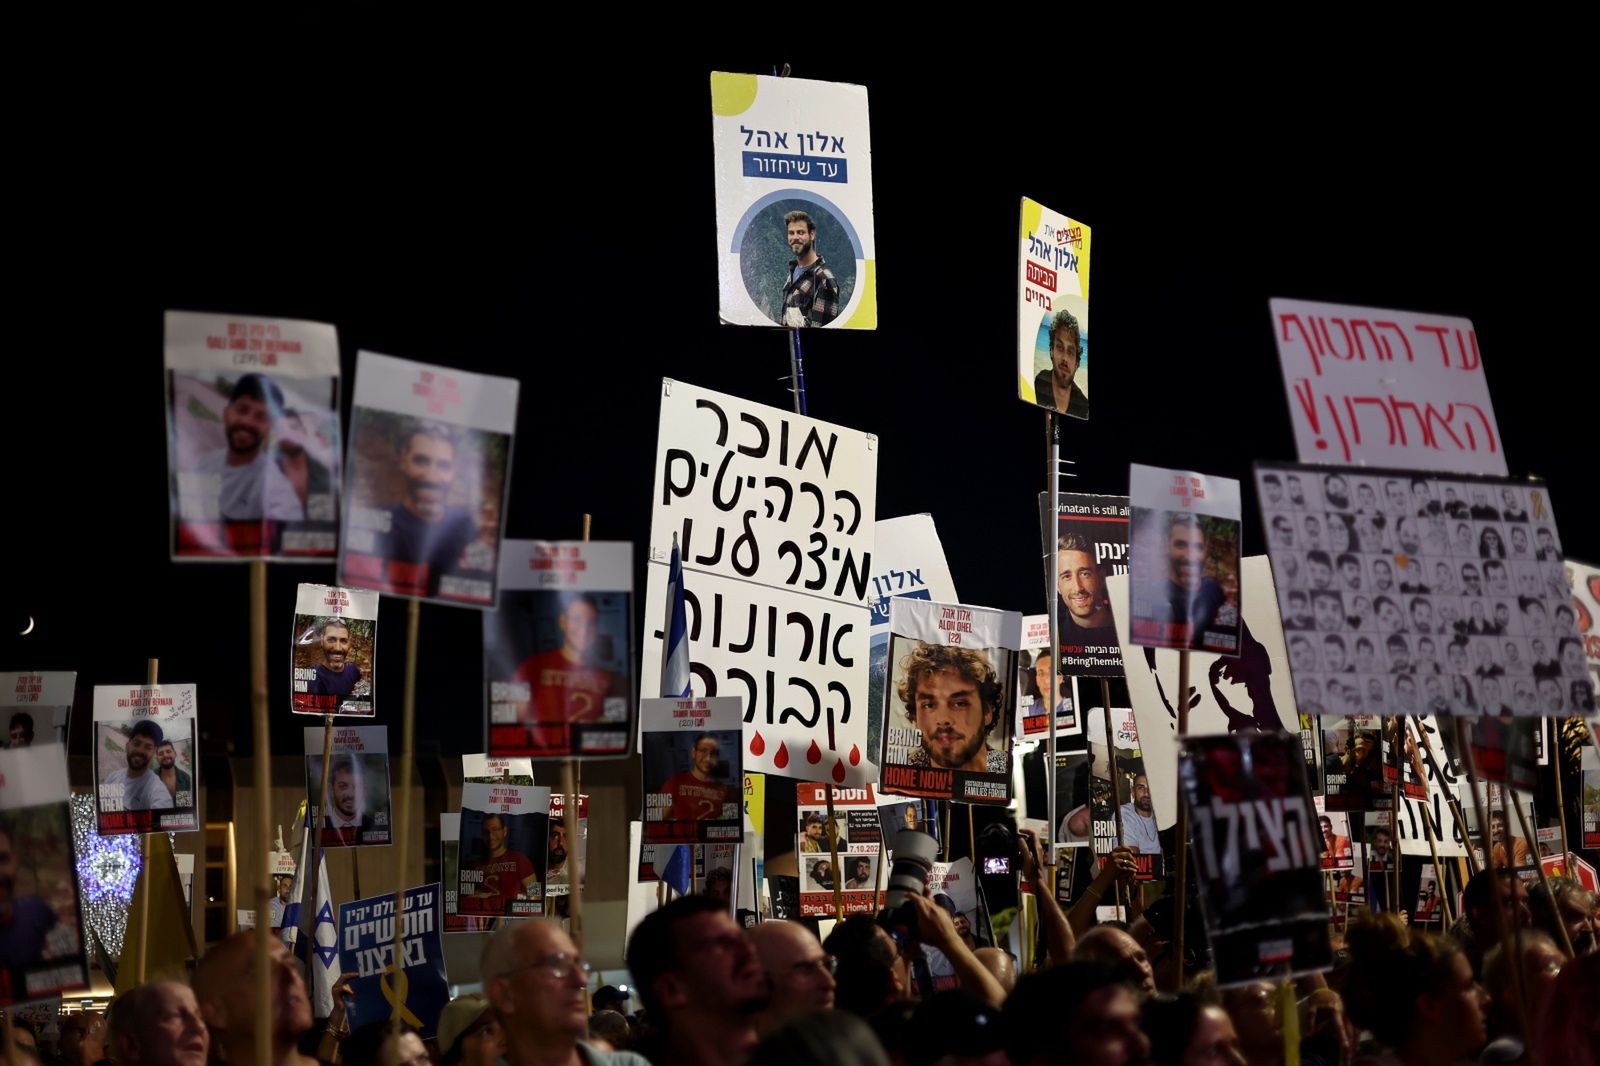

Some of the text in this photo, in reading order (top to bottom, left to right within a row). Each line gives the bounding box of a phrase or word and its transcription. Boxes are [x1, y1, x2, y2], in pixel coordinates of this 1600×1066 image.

[740, 125, 845, 156] אלון אהל
[753, 157, 838, 177] עד שיחזור
[1028, 231, 1052, 262] אהל
[1055, 246, 1079, 273] אלון
[1027, 263, 1055, 289] הביתה
[1025, 286, 1052, 311] בחיים
[1279, 314, 1480, 377] עד החטוף
[1294, 378, 1497, 463] האחרון!
[696, 399, 838, 479] מוכר
[663, 448, 861, 536] הרהיטים
[1058, 503, 1131, 517] vinatan is still ali
[777, 532, 871, 601] מיצר
[872, 568, 926, 597] אלון
[942, 607, 955, 619] אהל
[938, 619, 973, 633] ALON OHEL
[948, 632, 962, 644] (22)
[1085, 646, 1108, 654] הביתה
[1062, 656, 1123, 668] #BringThemHo
[294, 667, 317, 681] BRING
[294, 680, 308, 693] HIM
[888, 728, 923, 748] BRING
[885, 748, 909, 766] HIM
[884, 766, 954, 791] HOME NOW!
[1326, 774, 1347, 784] BRING
[99, 783, 125, 798] BRING
[815, 788, 867, 801] חטופם
[1327, 784, 1340, 795] HIM
[646, 793, 672, 807] BRING
[646, 807, 663, 821] HIM
[1093, 820, 1117, 837] BRIN
[460, 869, 484, 883] BRING
[445, 890, 458, 902] BRI
[460, 883, 475, 896] HIM
[346, 892, 433, 924] עד שולם יהיו
[803, 904, 824, 915] Bring
[846, 902, 868, 912] Home
